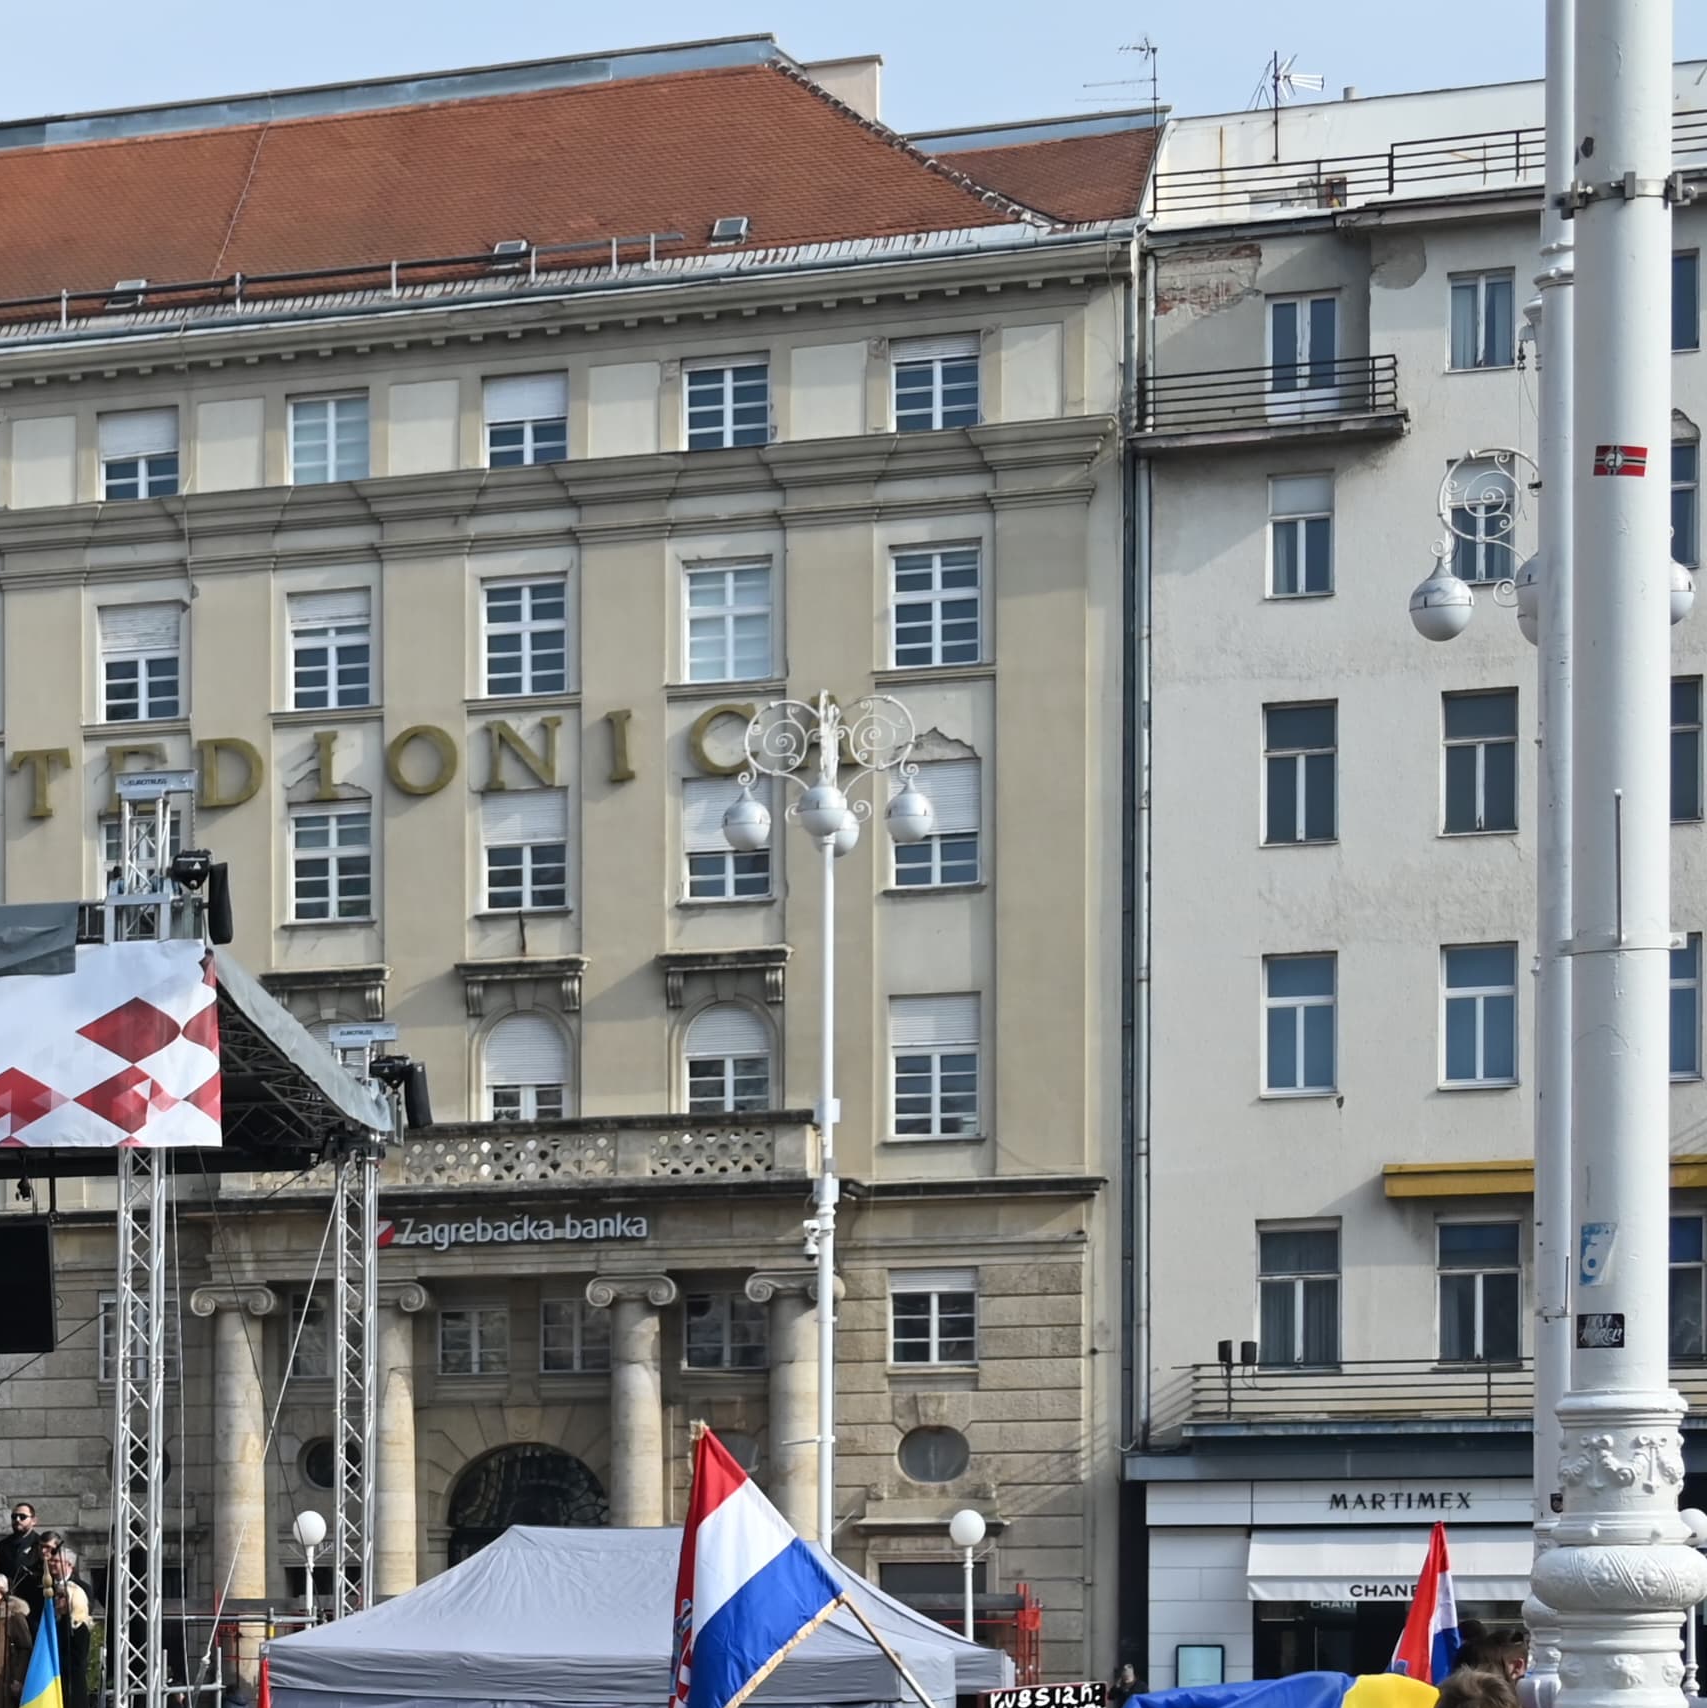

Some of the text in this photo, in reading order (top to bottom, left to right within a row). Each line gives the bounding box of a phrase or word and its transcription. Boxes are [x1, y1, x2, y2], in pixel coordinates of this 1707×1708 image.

[399, 1211, 649, 1251] Zagrebačka banka
[1329, 1491, 1472, 1511] MARTIMEX
[1349, 1584, 1419, 1598] CHANE
